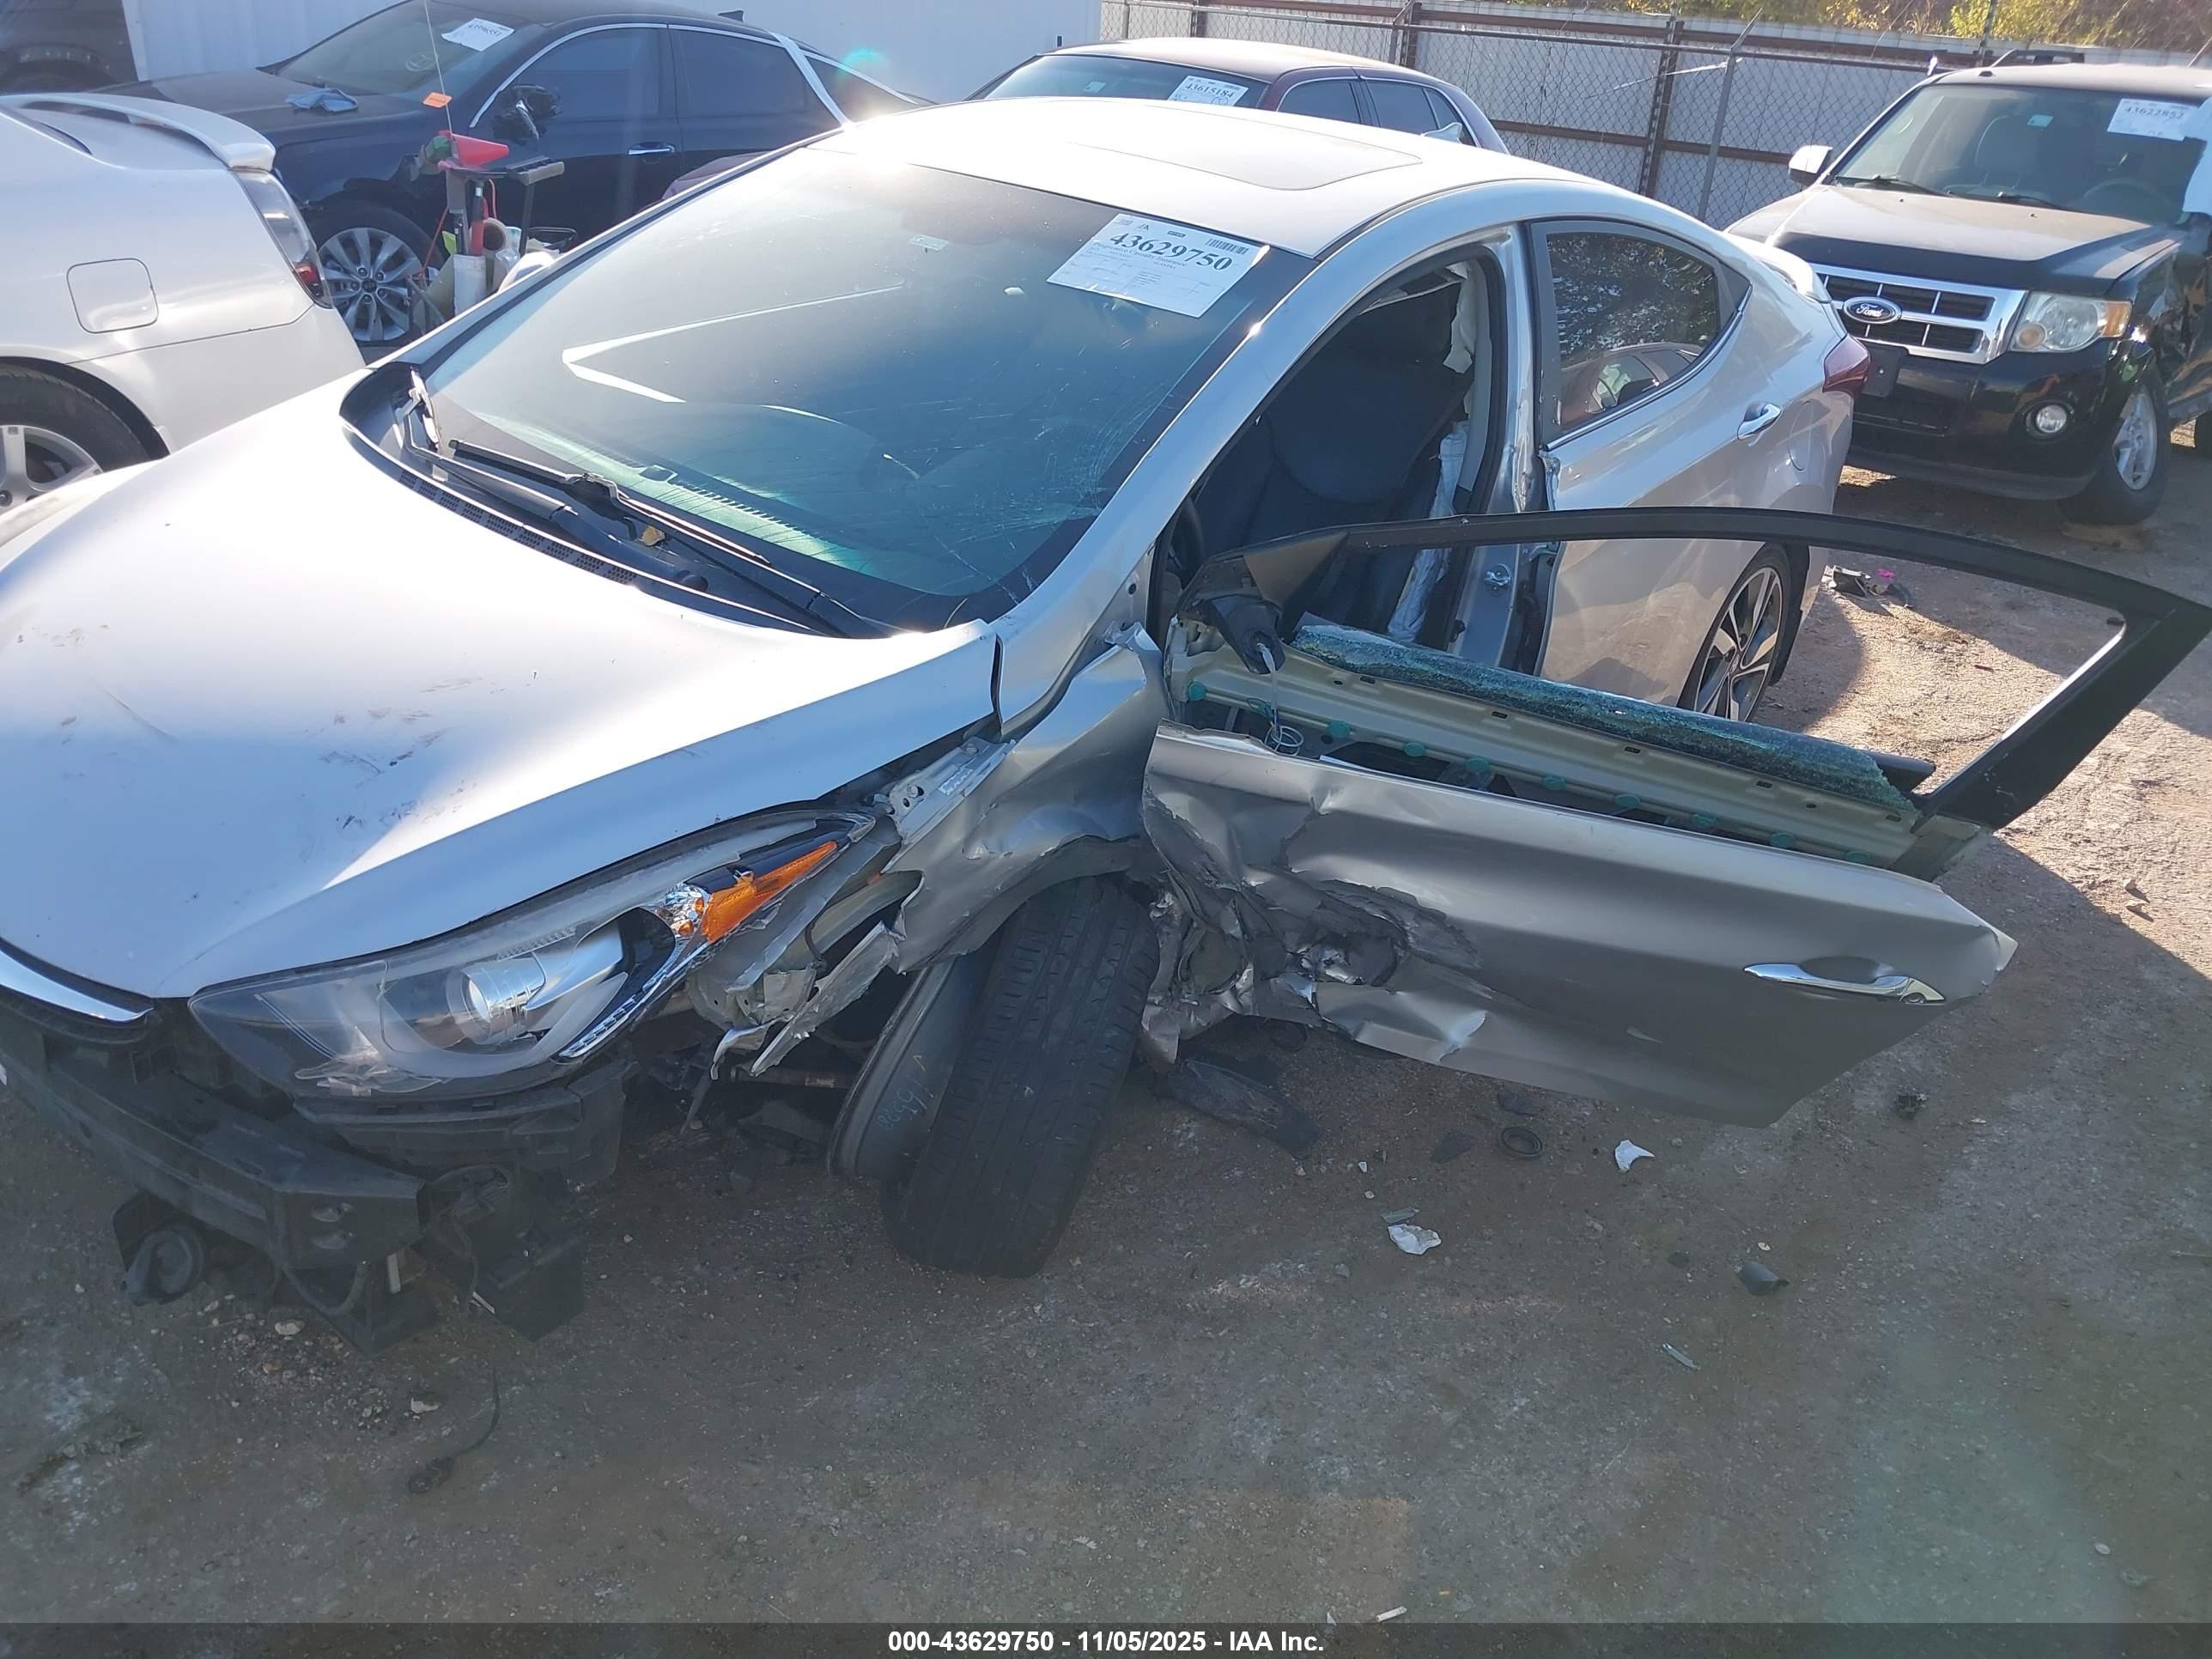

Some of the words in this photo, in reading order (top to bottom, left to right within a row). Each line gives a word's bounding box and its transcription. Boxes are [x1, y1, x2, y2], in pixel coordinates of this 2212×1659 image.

[1185, 83, 1235, 98] 43615184
[1109, 233, 1233, 271] 43629750
[1856, 303, 1883, 318] Ford
